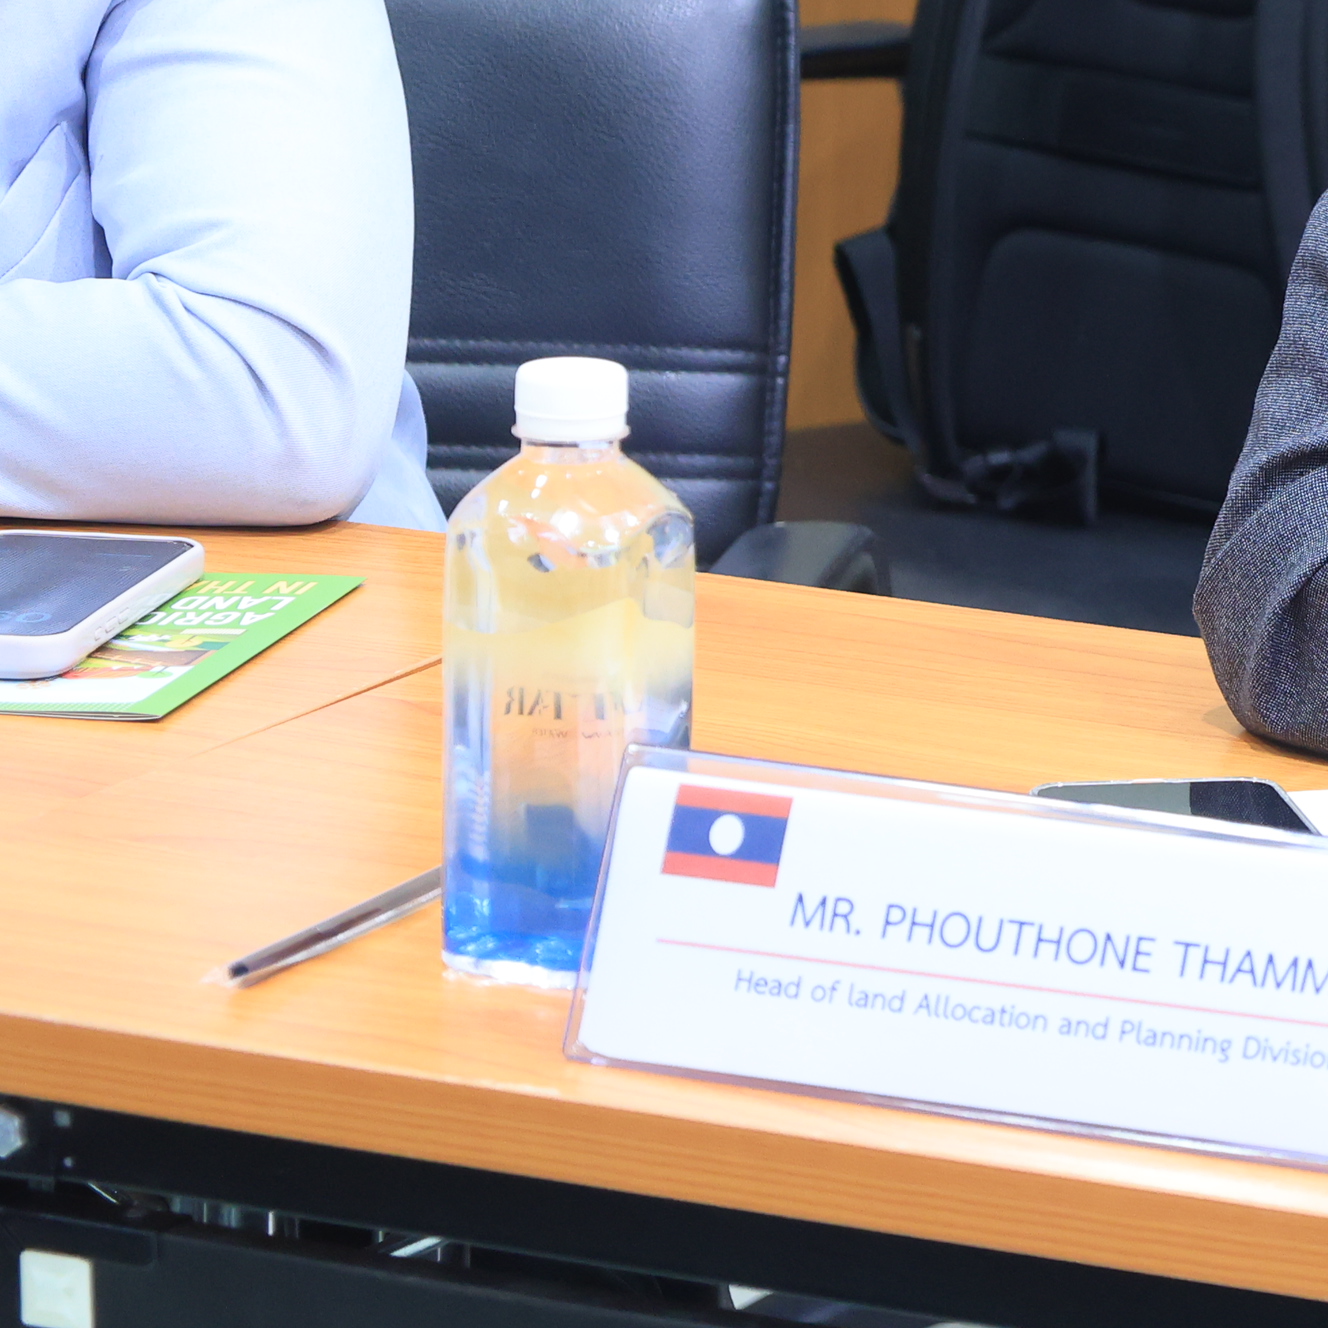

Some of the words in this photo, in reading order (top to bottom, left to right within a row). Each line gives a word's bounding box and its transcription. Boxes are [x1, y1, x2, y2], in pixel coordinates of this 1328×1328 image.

[262, 580, 318, 594] IN
[170, 595, 296, 610] LAND
[136, 611, 277, 626] AGRIC
[789, 892, 861, 936] MR.
[881, 903, 1156, 973] PHOUTHONE
[734, 969, 802, 1000] Head
[810, 979, 841, 1005] of
[847, 983, 907, 1014] land
[913, 993, 1049, 1033] Allocation
[1057, 1016, 1111, 1041] and
[1118, 1019, 1233, 1063] Planning
